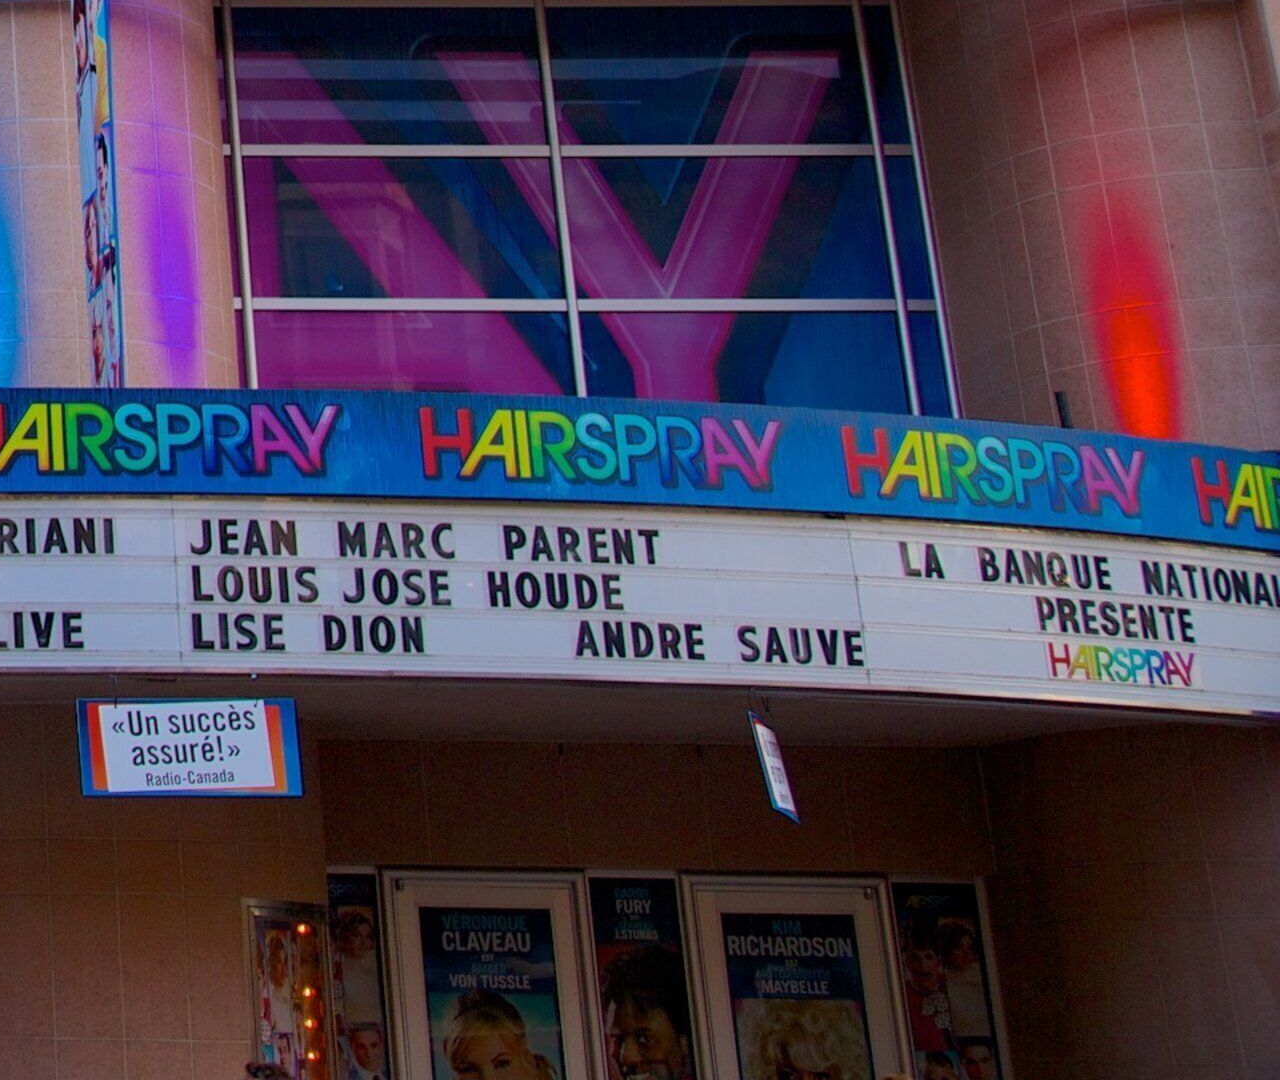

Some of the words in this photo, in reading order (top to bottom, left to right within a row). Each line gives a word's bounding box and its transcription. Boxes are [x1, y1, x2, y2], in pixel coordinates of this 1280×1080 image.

[419, 406, 782, 491] HAIRSPRAY
[841, 429, 1145, 518] HAIRSPRAY
[190, 519, 298, 558] JEAN
[338, 520, 456, 560] MARC
[502, 523, 660, 565] PARENT
[899, 541, 945, 580] LA
[977, 546, 1113, 591] BANQUE
[191, 566, 320, 604] LOUIS
[343, 567, 452, 606] JOSE
[488, 570, 625, 610] HOUDE
[191, 613, 287, 652] LISE
[323, 615, 426, 654] DION
[1035, 596, 1196, 644] PRESENTE
[575, 620, 706, 661] ANDRE
[740, 625, 865, 668] SAUVE
[1047, 642, 1196, 687] HAIRSPRAY
[112, 710, 159, 736] «Un
[168, 704, 256, 736] succès
[132, 736, 241, 766] assuré!»
[146, 770, 235, 787] Radio-Canada
[616, 899, 651, 914] FURY
[442, 931, 531, 952] CLAVEAU
[772, 920, 800, 935] KIM
[728, 936, 853, 958] RICHARDSON
[449, 975, 476, 988] VON
[482, 975, 532, 991] TUSSLE
[759, 979, 829, 994] MAYBELLE
